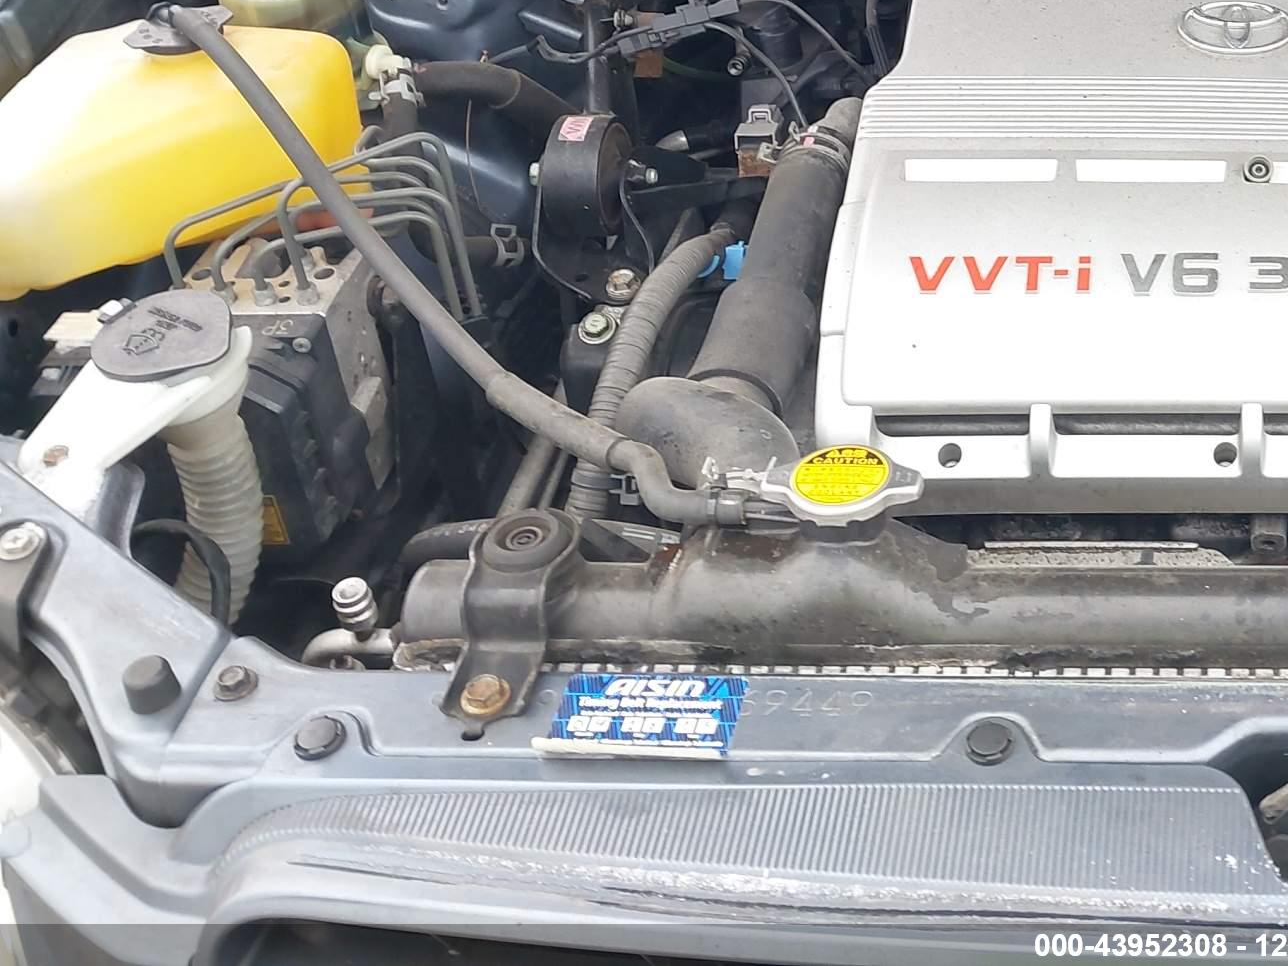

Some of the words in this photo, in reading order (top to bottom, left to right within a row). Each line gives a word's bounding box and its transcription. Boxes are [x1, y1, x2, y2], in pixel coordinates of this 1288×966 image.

[909, 255, 1093, 295] VVT-i
[1120, 252, 1220, 296] V6
[812, 457, 879, 465] CAUTION
